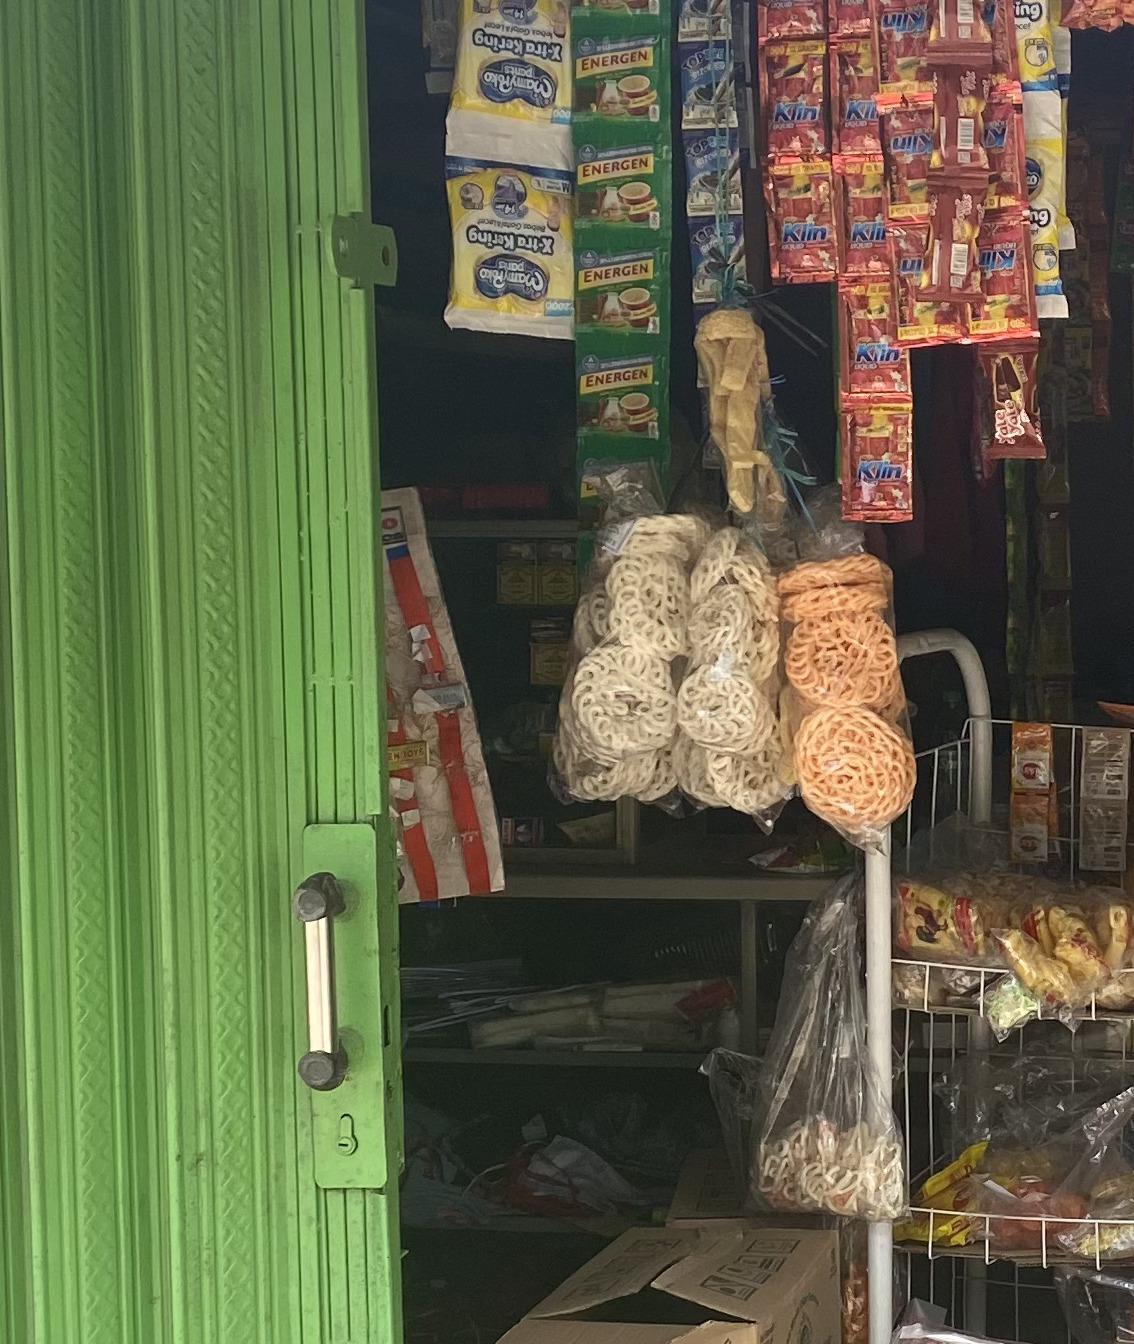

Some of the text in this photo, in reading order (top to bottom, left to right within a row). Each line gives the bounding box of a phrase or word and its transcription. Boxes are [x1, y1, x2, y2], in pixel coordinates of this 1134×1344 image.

[473, 27, 563, 62] X-tra Kering
[503, 64, 535, 79] pants
[581, 50, 649, 72] ENERGEN
[773, 102, 819, 122] Klin
[891, 134, 933, 155] Klin
[582, 157, 649, 178] ENERGEN
[466, 225, 555, 256] X-tra Kering
[781, 222, 829, 242] Klin
[497, 260, 525, 272] pants
[583, 262, 649, 283] ENERGEN
[855, 343, 902, 364] Klin
[585, 369, 649, 388] ENERGEN
[857, 459, 905, 481] Klin
